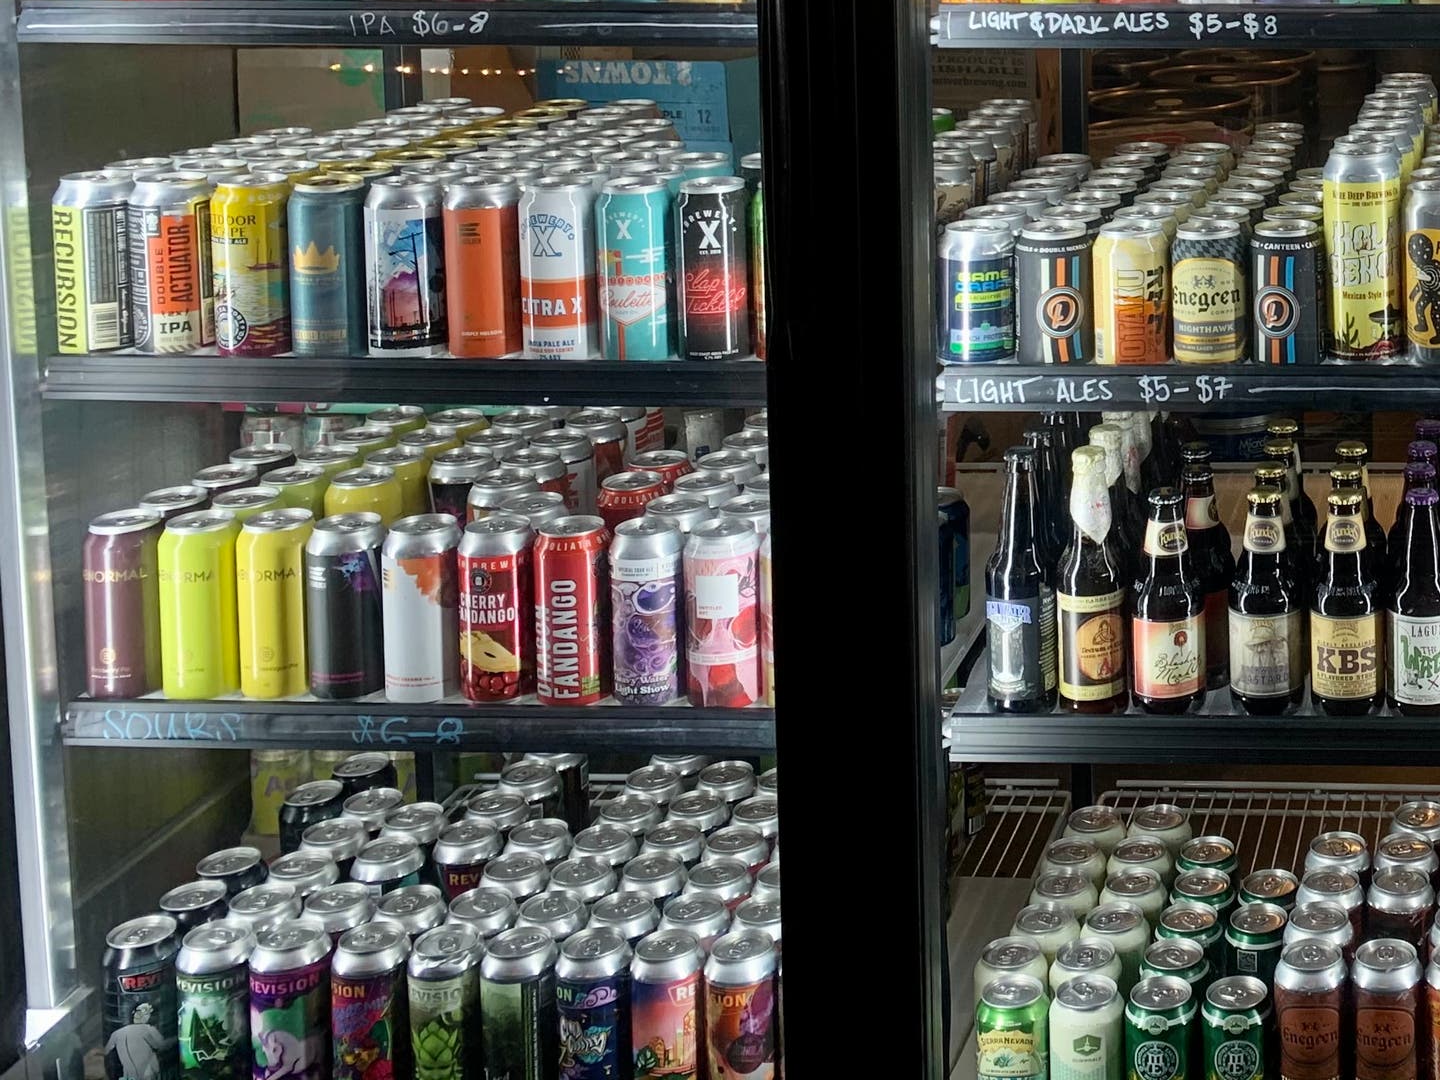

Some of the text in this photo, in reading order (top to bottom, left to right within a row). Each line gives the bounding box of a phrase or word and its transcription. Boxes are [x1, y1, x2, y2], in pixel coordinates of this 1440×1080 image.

[350, 10, 490, 38] IPA $6-8
[968, 11, 1031, 32] LIGHT
[1051, 13, 1113, 35] DARK
[1113, 12, 1170, 33] ALES
[1188, 12, 1278, 41] $5-$8
[699, 220, 723, 250] X
[1263, 241, 1302, 251] CANTEEN
[154, 247, 166, 305] DOUBLE
[168, 223, 194, 305] ACTUATOR
[53, 210, 80, 349] RECURSION
[522, 296, 583, 316] CITRA X
[1173, 286, 1241, 313] Enegren
[159, 321, 193, 335] IPA
[1178, 324, 1234, 334] NIGHTHAWK
[954, 375, 1234, 404] LIGHT ALES $5-$7
[459, 593, 506, 610] CHERRY
[550, 578, 580, 700] FANDANGO
[1317, 646, 1377, 674] KBS
[102, 708, 241, 741] SOURS
